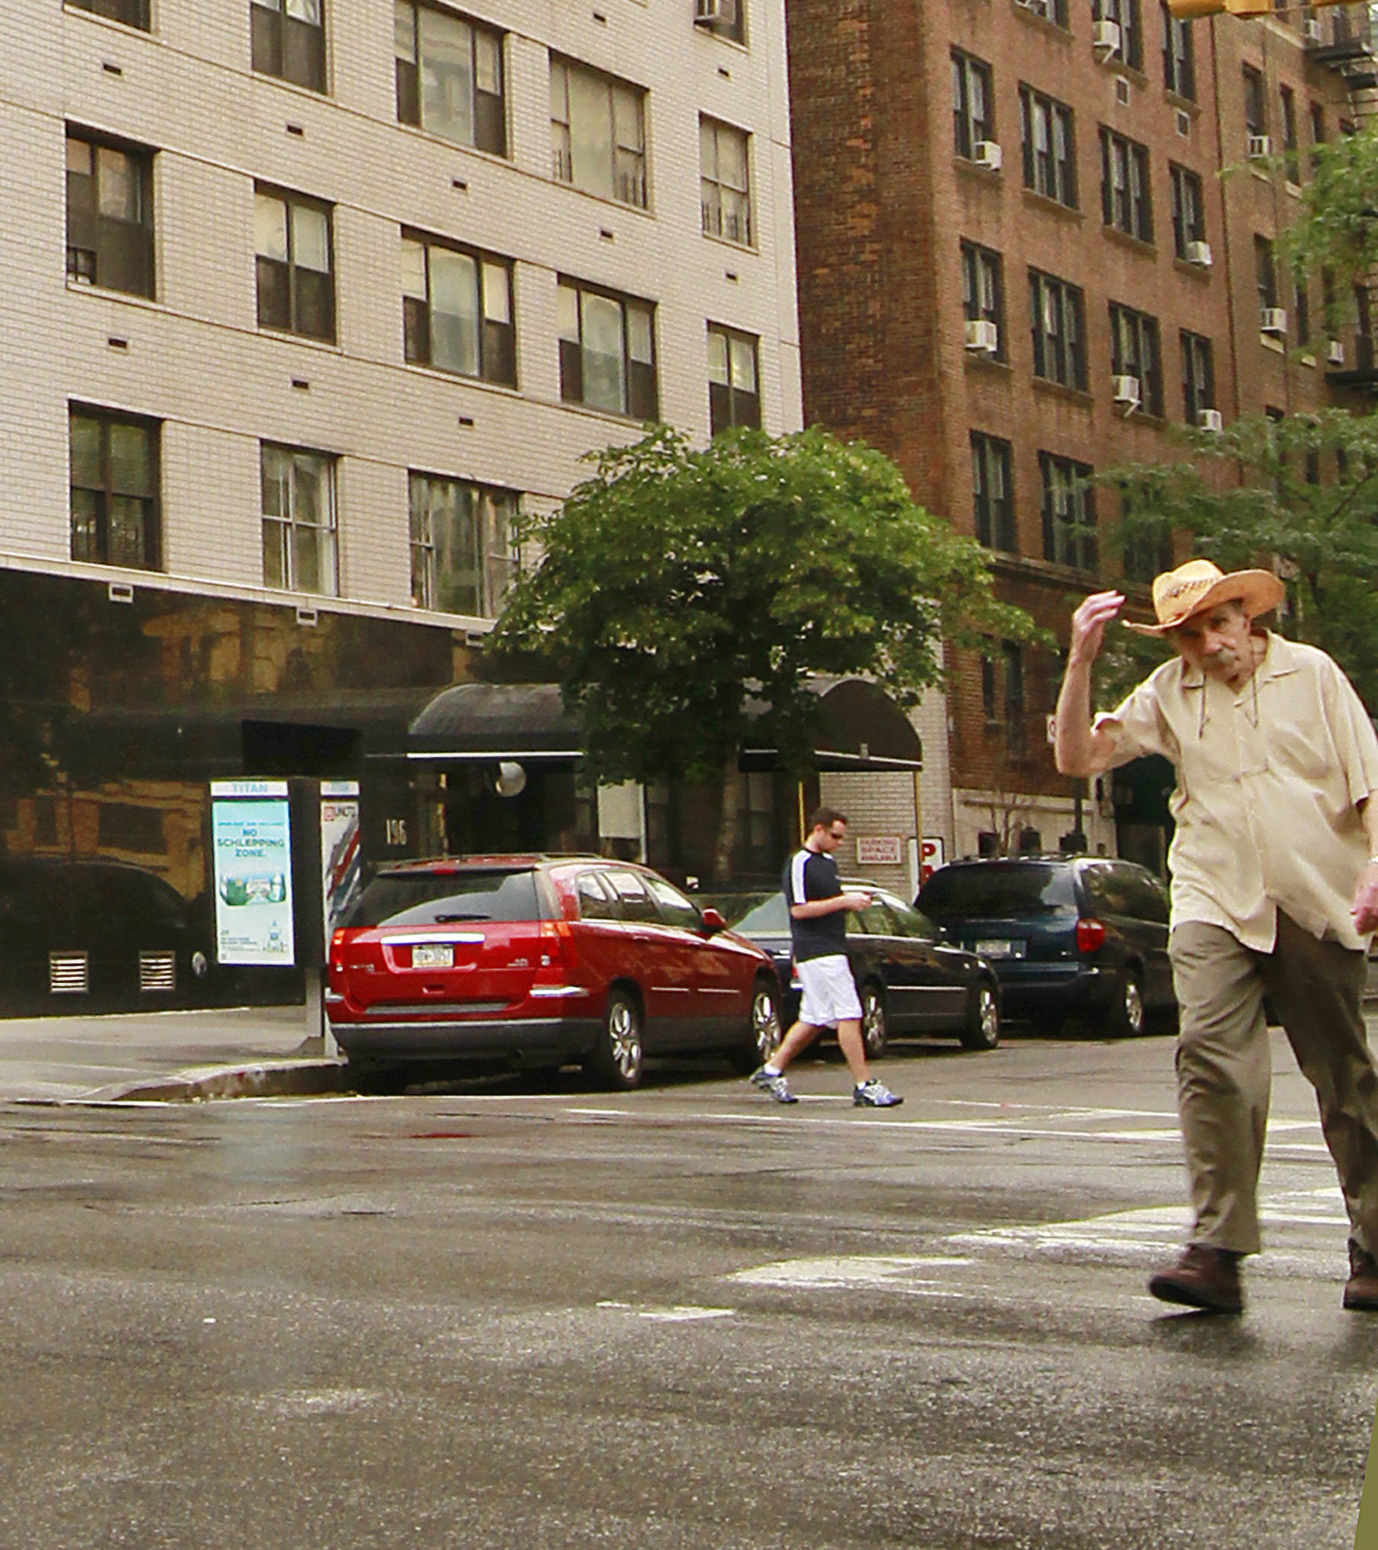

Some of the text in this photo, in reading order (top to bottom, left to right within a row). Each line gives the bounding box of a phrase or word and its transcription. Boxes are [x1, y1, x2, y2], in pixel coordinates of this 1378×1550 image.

[232, 782, 268, 793] TITAN
[242, 828, 258, 837] NO
[217, 837, 286, 848] SCHLEPPING
[235, 848, 267, 858] ZONE.
